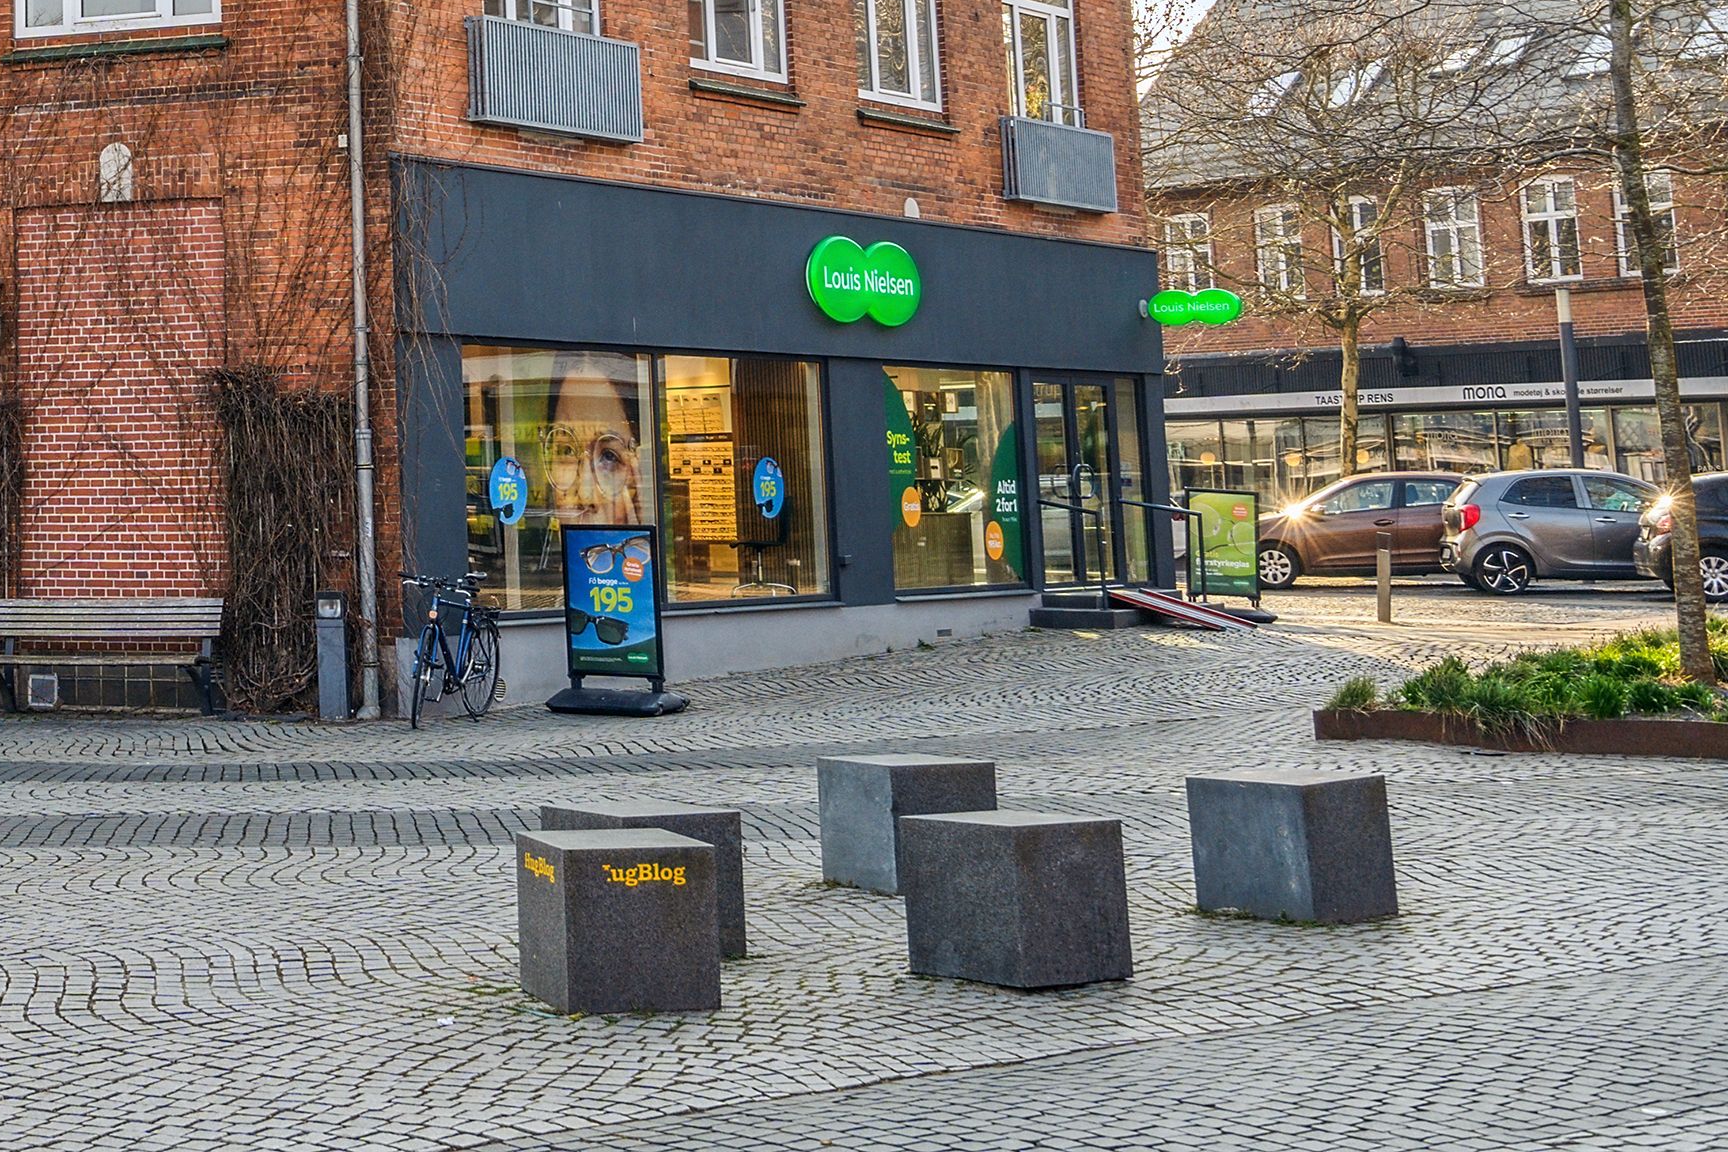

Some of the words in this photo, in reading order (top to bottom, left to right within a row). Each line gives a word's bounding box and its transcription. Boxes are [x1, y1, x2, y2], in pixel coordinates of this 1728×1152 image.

[823, 265, 861, 291] Louis
[864, 269, 914, 296] Nielsen
[1153, 302, 1184, 313] Louis
[1187, 301, 1230, 311] Nielsen
[1315, 394, 1365, 405] TAASP
[1367, 393, 1394, 403] RENS
[1463, 386, 1507, 400] mona
[1544, 388, 1550, 396] &
[886, 430, 910, 448] Syns-
[893, 450, 911, 464] test
[498, 483, 518, 501] 195
[760, 481, 777, 497] 195
[997, 479, 1016, 494] Altid
[597, 577, 618, 586] begge
[589, 586, 634, 613] 195
